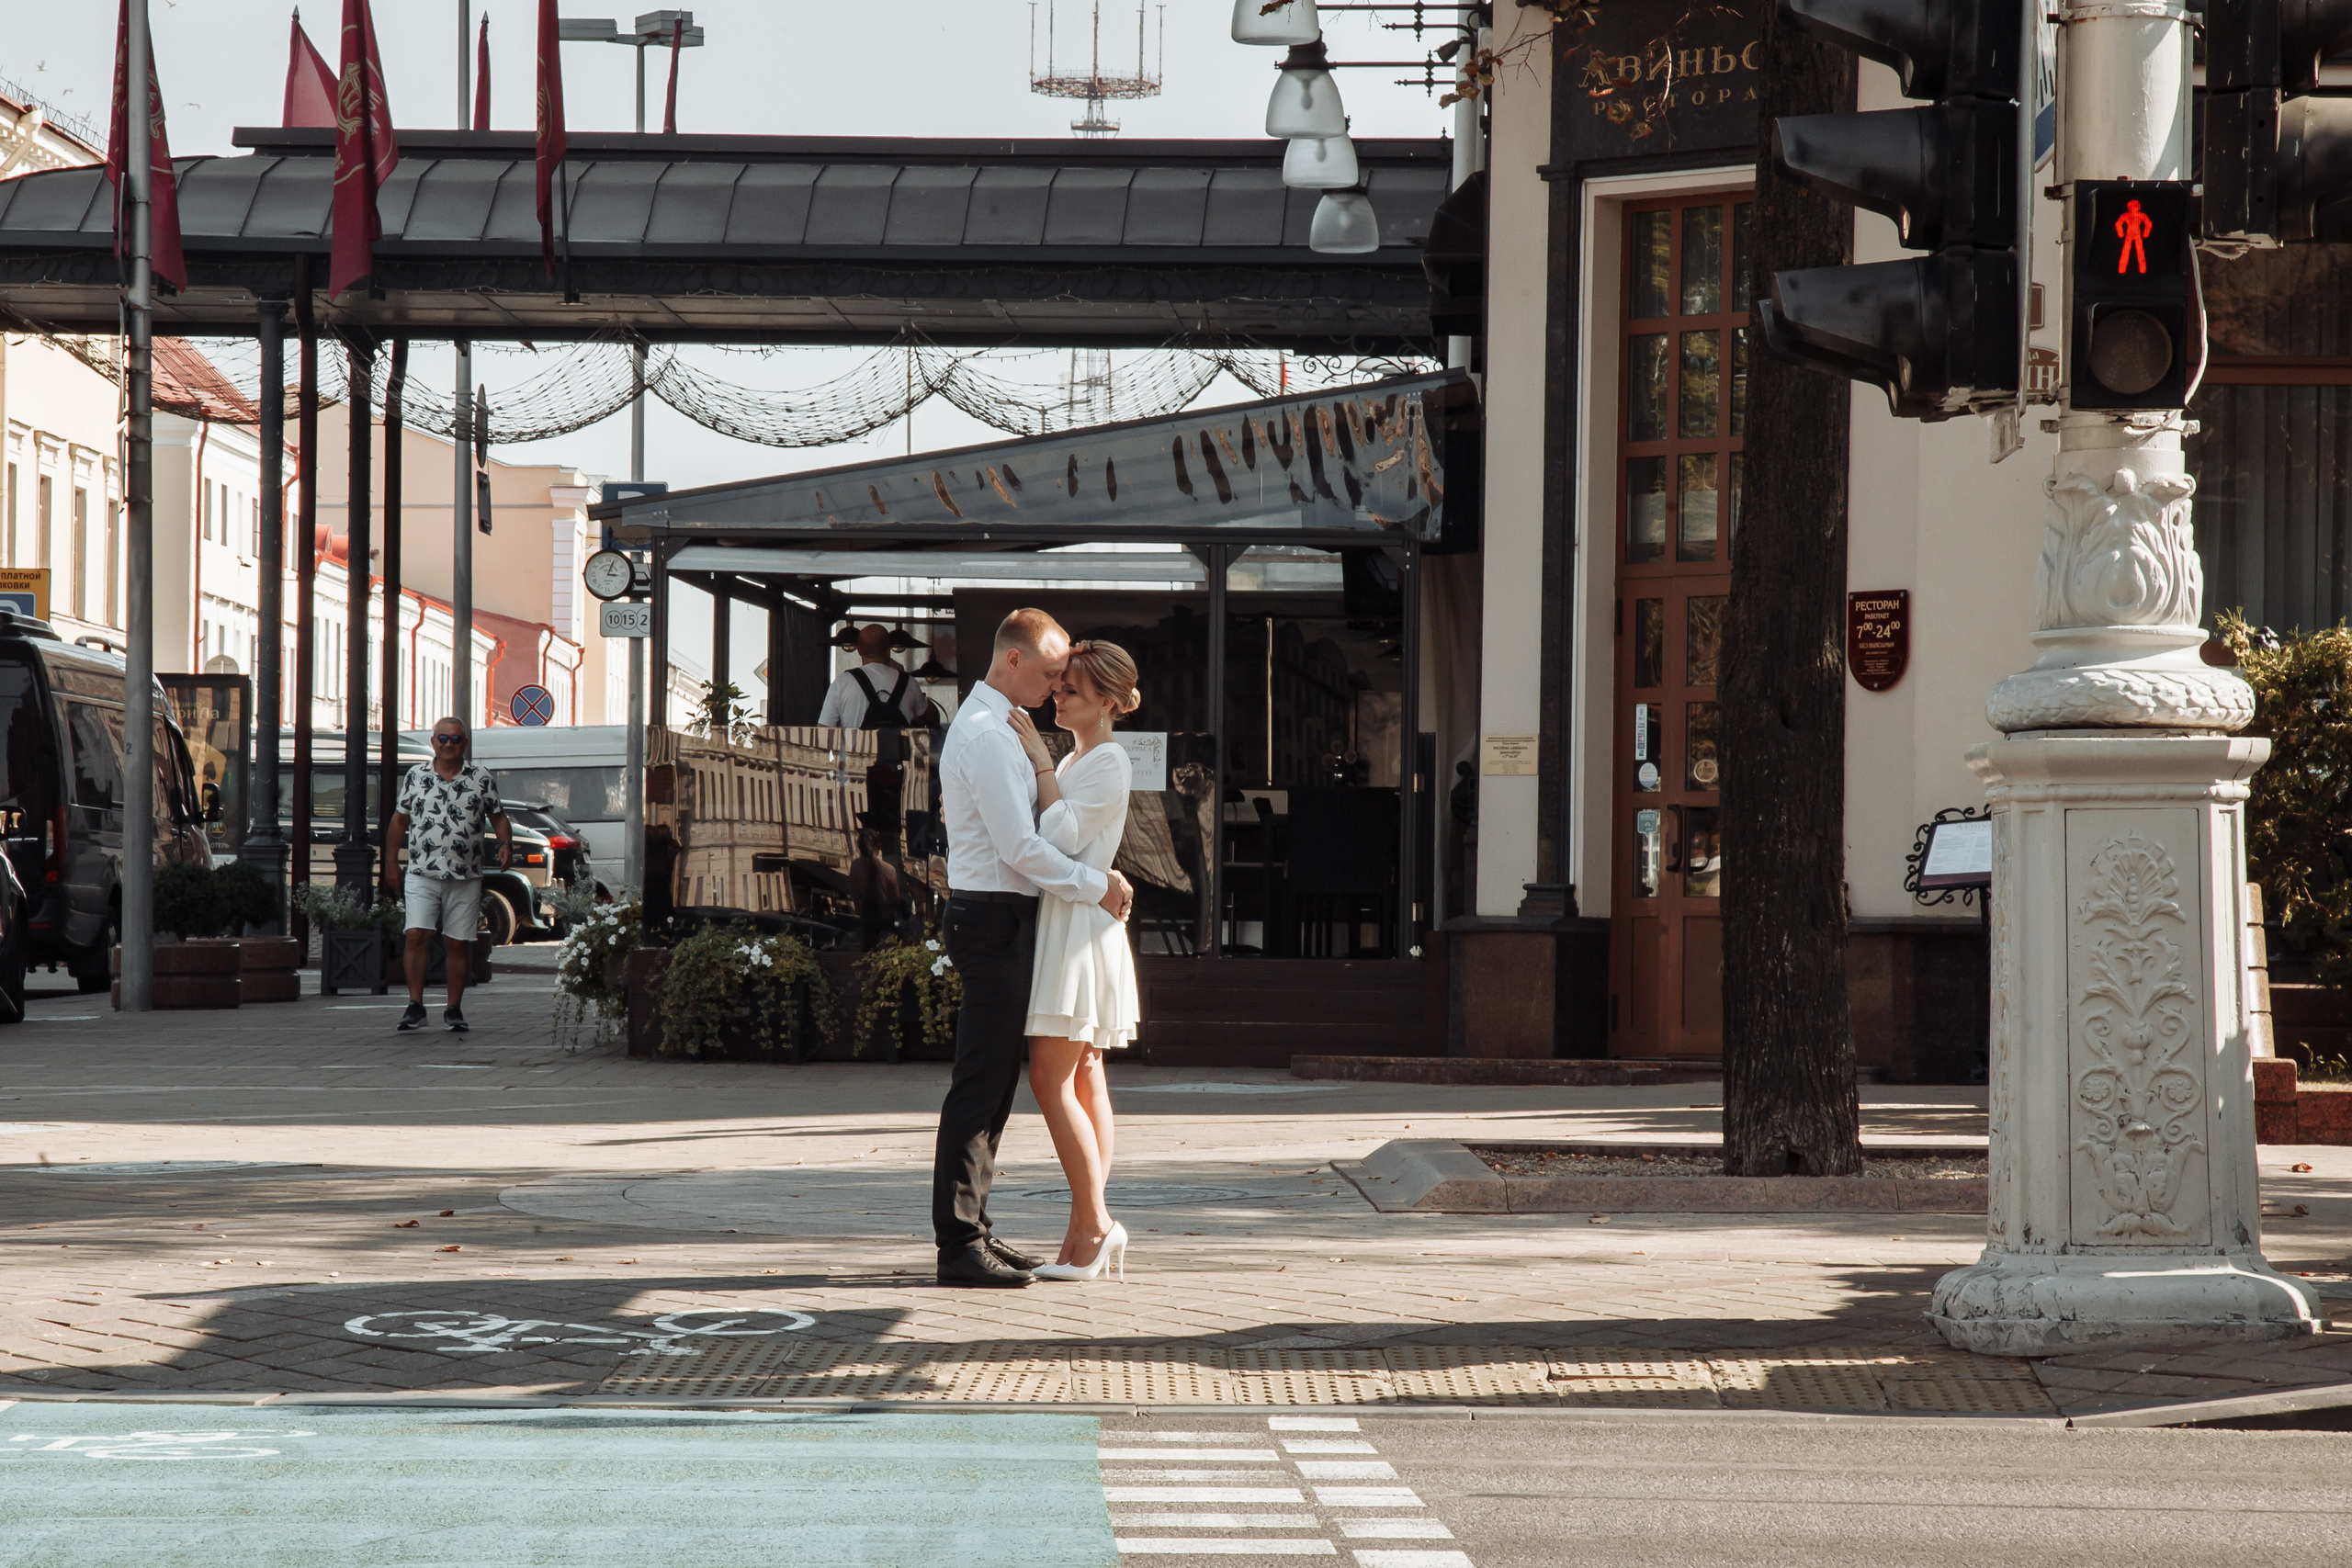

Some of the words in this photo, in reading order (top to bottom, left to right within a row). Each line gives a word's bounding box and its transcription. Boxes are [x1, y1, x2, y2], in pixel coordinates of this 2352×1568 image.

[1, 571, 41, 580] платной
[1855, 600, 1900, 611] РЕСТОРАН
[609, 615, 620, 625] 10
[623, 615, 635, 626] 15
